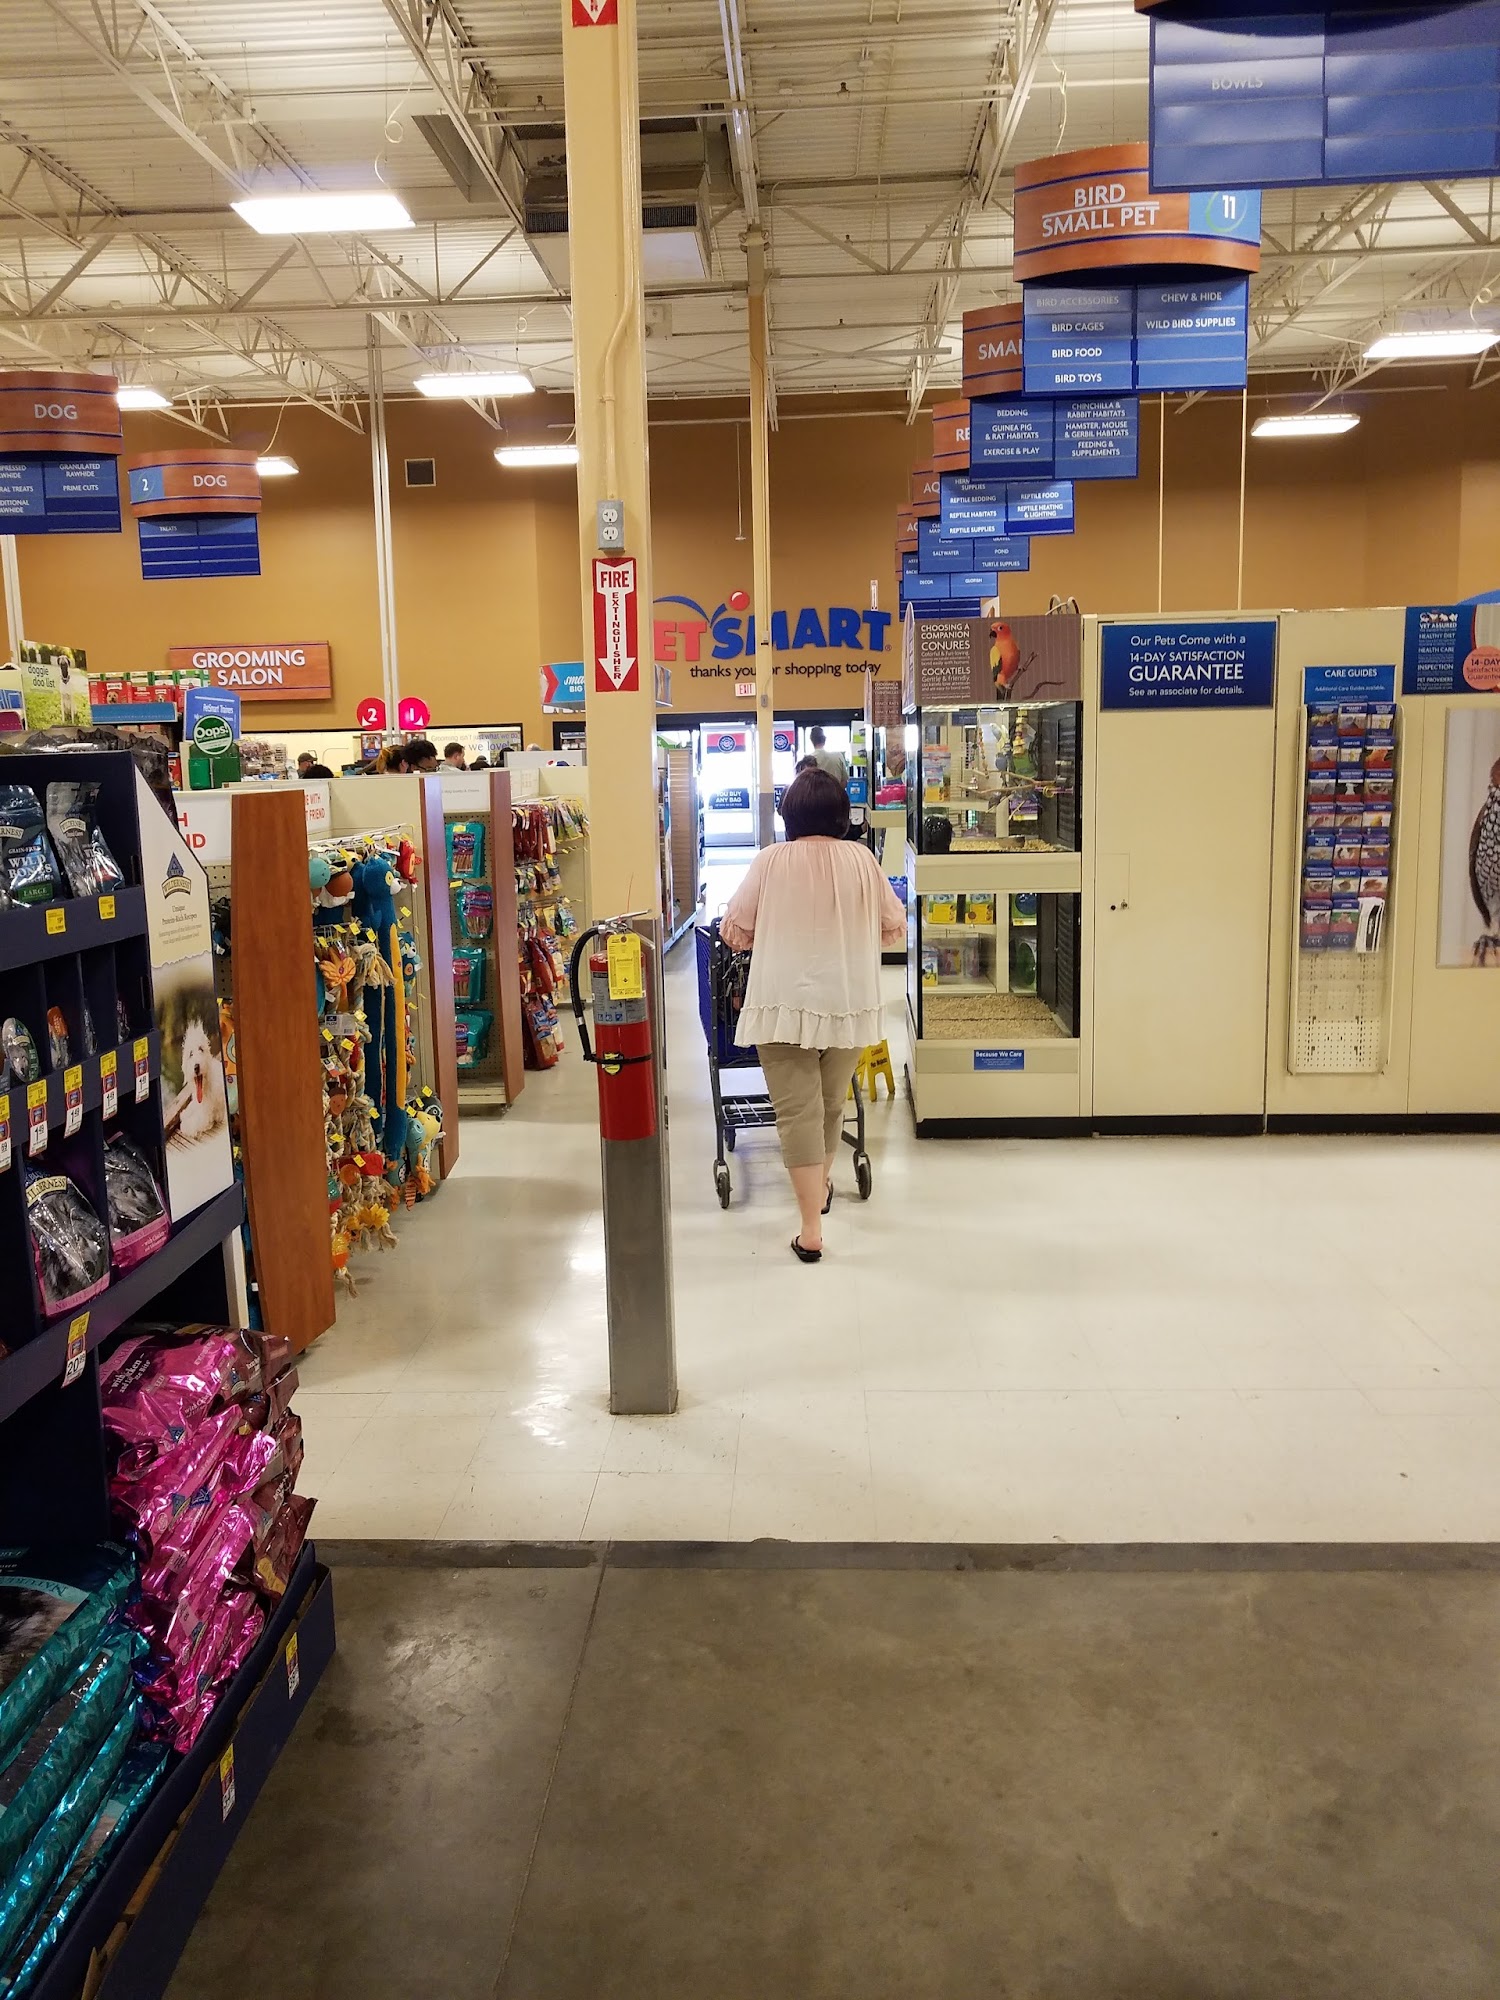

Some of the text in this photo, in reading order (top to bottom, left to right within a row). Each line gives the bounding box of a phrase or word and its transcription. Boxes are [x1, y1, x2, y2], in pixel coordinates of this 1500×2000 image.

[1211, 78, 1264, 91] BOWLS
[1074, 183, 1126, 208] BIRD
[1222, 194, 1236, 220] 11
[1042, 206, 1160, 238] SMALL PET
[1036, 296, 1120, 307] BIRD ACCESSORIES
[1161, 292, 1222, 303] CHEW & HIDE
[1051, 322, 1104, 333] BIRD CAGES
[1146, 317, 1236, 330] WILD BIRD SUPPLIES
[1052, 348, 1102, 358] BIRD FOOD
[1055, 373, 1102, 383] BIRD TOYS
[34, 403, 78, 420] DOG
[1072, 402, 1114, 410] CHINCHILLA
[996, 409, 1029, 417] BEDDING
[1067, 410, 1125, 419] RABBIT HABITATS
[991, 424, 1032, 433] GUINEA PIG
[1065, 421, 1128, 430] HAMSTER, MOUSE
[985, 433, 991, 441] &
[1006, 431, 1039, 440] HABITATS
[1064, 429, 1129, 439] & GERBIL HABITATS
[1077, 441, 1107, 449] FEEDING
[983, 448, 1015, 456] EXERCISE
[1022, 447, 1040, 455] PLAY
[1071, 449, 1121, 457] SUPPLEMENTS
[142, 478, 149, 491] 2
[193, 475, 228, 488] DOG
[1021, 492, 1041, 500] REPTILE
[600, 570, 630, 588] FIRE
[921, 623, 963, 632] CHOOSING
[612, 592, 622, 680] EXTINGUISHER
[921, 631, 970, 639] COMPANION
[1130, 633, 1246, 647] Our Pets Come with a
[921, 640, 971, 651] CONURES
[192, 650, 306, 670] GROOMING
[1130, 650, 1245, 663] 14-DAY SATISFACTION
[1471, 658, 1500, 666] 14-DAY
[28, 664, 49, 677] doggie
[690, 660, 881, 681] thanks you shopping today
[921, 667, 971, 676] COCKATIELS
[1129, 663, 1244, 682] GUARANTEE
[1324, 668, 1378, 678] CARE GUIDES
[32, 678, 56, 688] doo list
[217, 668, 284, 687] SALON
[569, 685, 583, 693] BIG
[739, 683, 753, 695] EXIT
[1128, 687, 1145, 697] See
[1160, 686, 1198, 696] associate
[1200, 685, 1212, 695] for
[1214, 686, 1245, 695] details.
[367, 708, 378, 722] 2
[409, 707, 415, 721] 1
[196, 721, 230, 739] Oops!
[468, 743, 484, 751] we
[8, 854, 47, 868] WILD
[8, 864, 53, 880] BONES
[23, 887, 48, 897] LARGE
